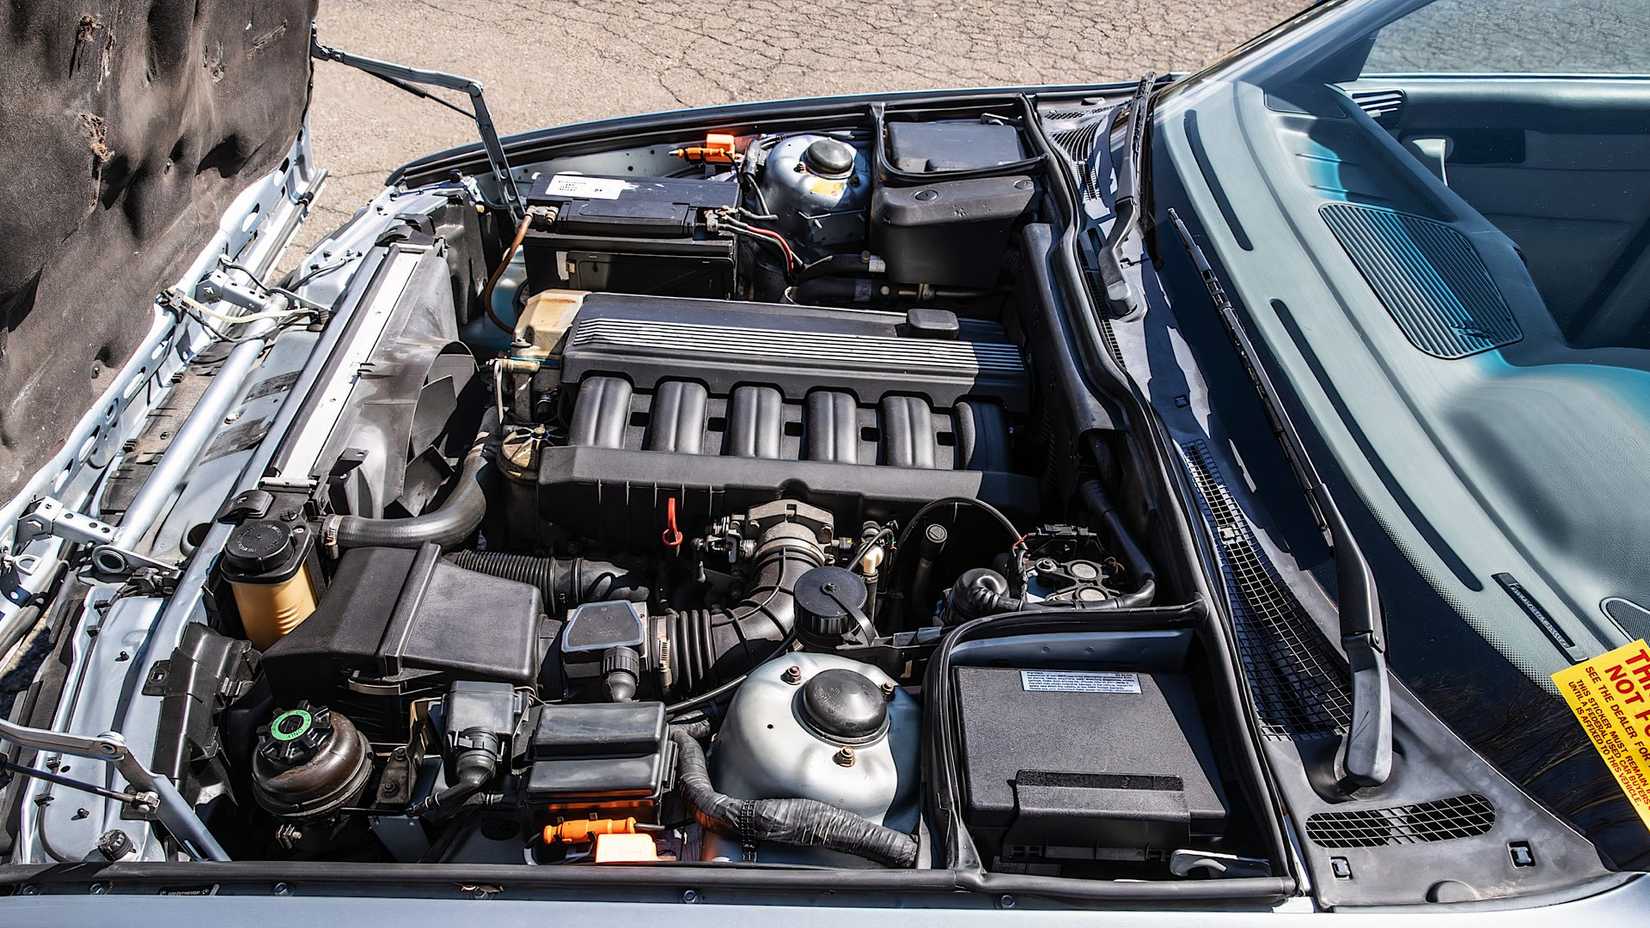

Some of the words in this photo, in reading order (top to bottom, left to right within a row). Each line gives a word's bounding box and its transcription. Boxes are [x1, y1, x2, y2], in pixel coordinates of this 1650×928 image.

[1568, 681, 1584, 701] UNTIL
[1585, 707, 1608, 739] FEDERAL
[1605, 739, 1621, 758] USED
[1619, 760, 1632, 774] CAR
[1585, 666, 1602, 684] SEE
[1598, 684, 1615, 703] THE
[1610, 704, 1638, 739] DEALER
[1634, 741, 1650, 761] FOR
[1604, 664, 1645, 704] NOT
[1576, 679, 1591, 697] THIS
[1588, 697, 1612, 729] STICKER
[1609, 731, 1629, 753] MUST
[1625, 755, 1649, 787] REMAIN
[1576, 706, 1585, 715] IS
[1581, 716, 1604, 745] AFFIXED
[1600, 745, 1610, 755] TO
[1607, 755, 1622, 773] THIS
